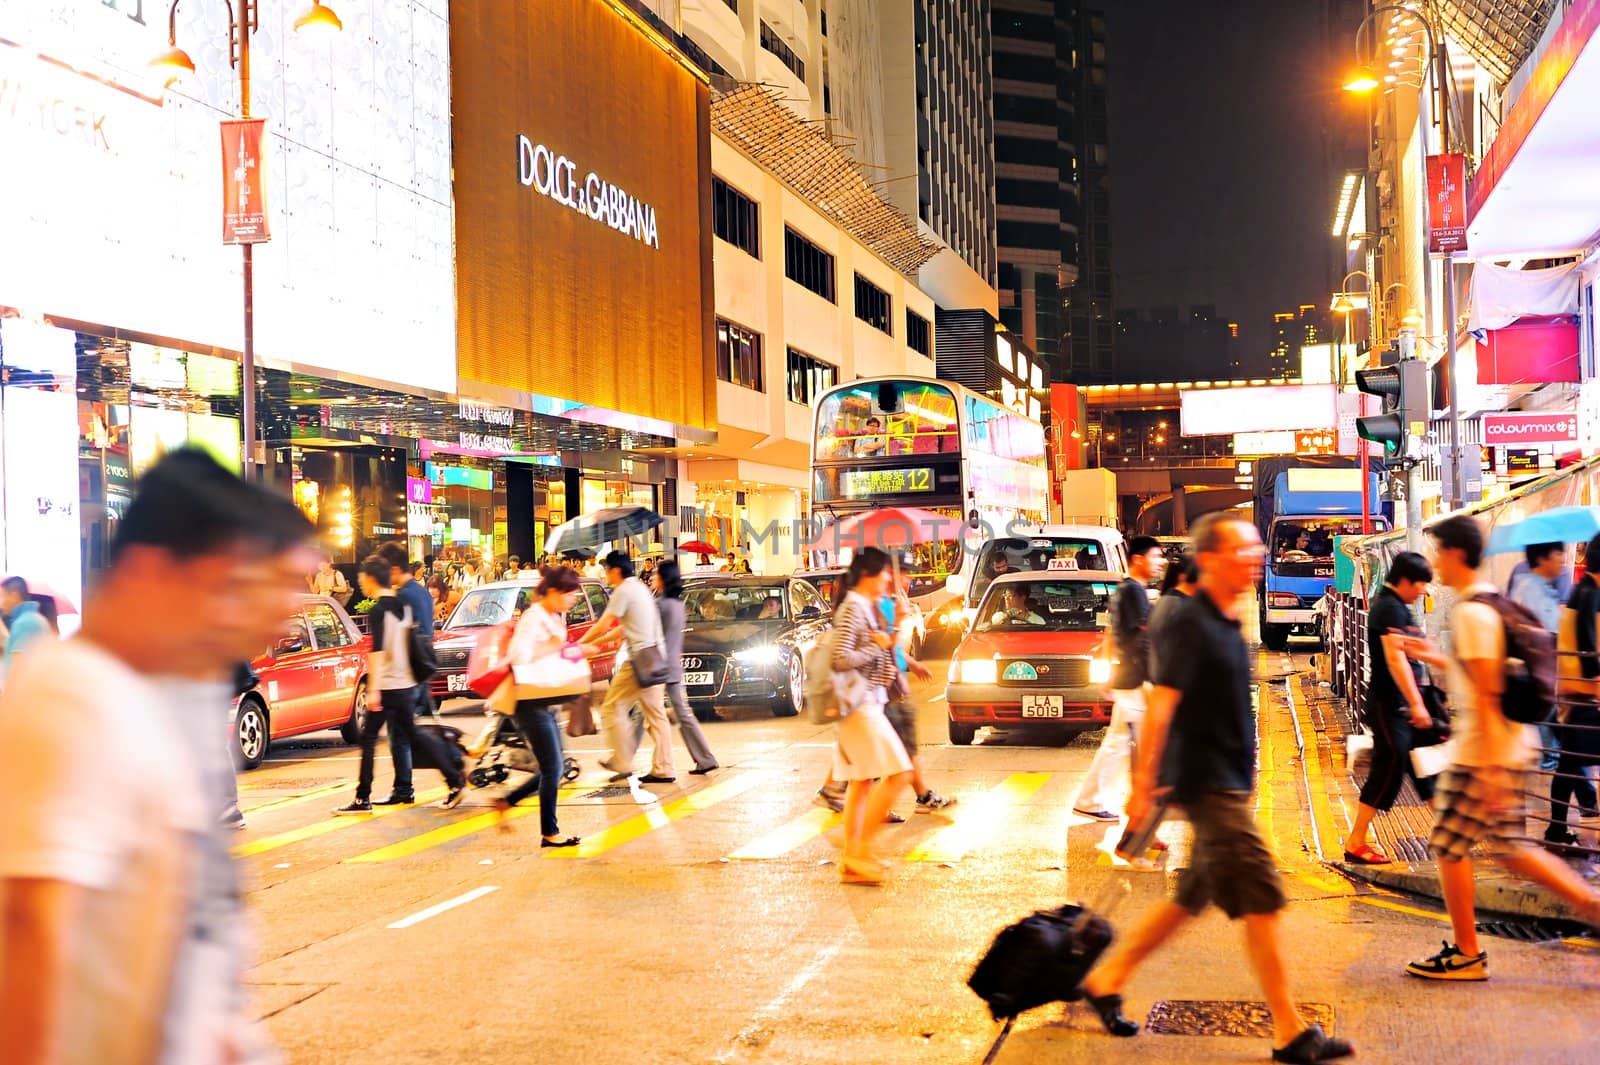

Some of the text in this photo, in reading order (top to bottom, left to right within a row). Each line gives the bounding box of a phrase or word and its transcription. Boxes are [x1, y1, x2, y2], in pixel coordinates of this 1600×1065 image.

[908, 468, 929, 490] 12
[1051, 560, 1075, 569] TAXI
[1034, 695, 1051, 707] LA
[1027, 706, 1059, 717] 5019
